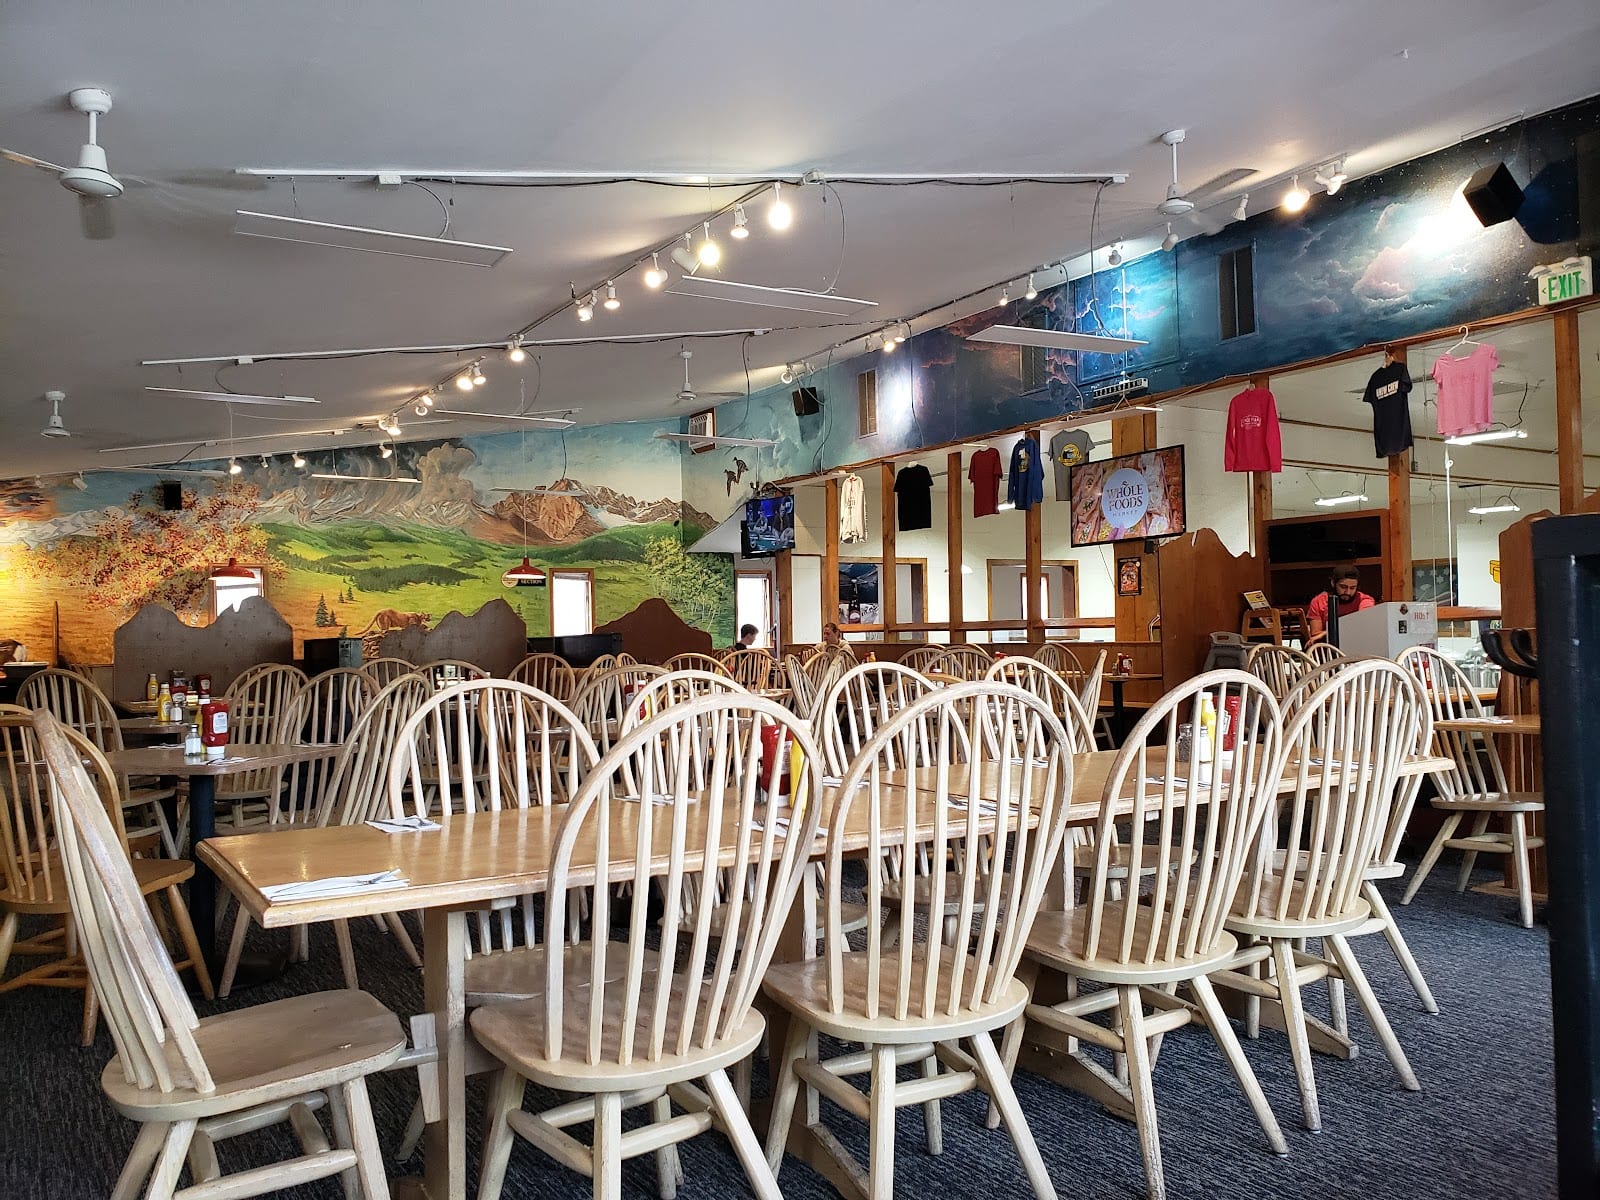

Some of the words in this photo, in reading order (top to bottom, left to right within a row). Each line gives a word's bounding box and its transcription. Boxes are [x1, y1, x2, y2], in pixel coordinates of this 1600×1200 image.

[1548, 271, 1581, 301] EXIT
[1106, 484, 1144, 500] WHOLE
[1109, 496, 1143, 512] FOODS
